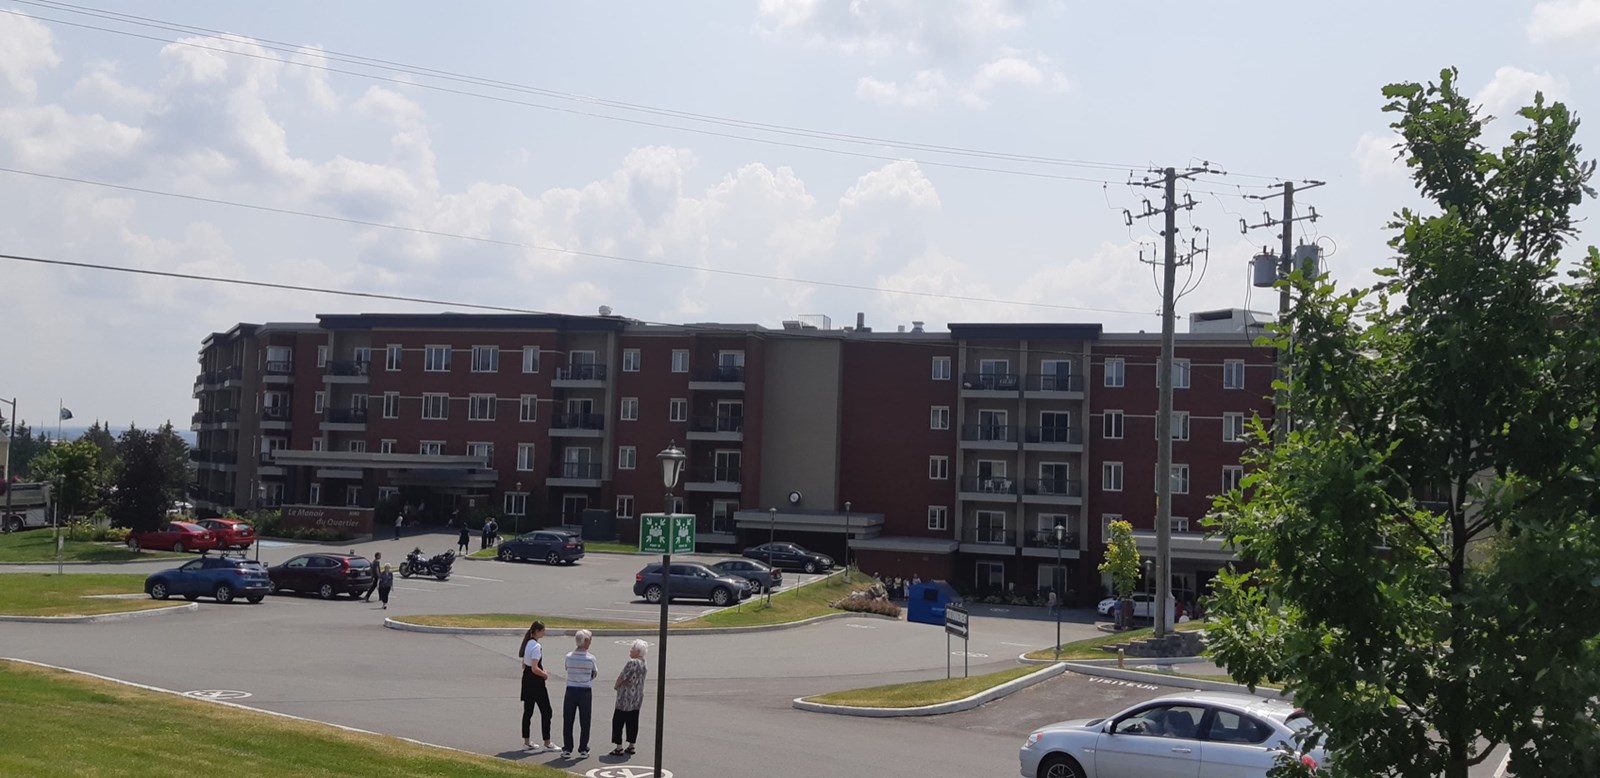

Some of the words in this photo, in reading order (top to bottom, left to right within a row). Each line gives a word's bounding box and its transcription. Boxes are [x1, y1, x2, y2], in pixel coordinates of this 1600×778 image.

[288, 508, 296, 516] Le
[297, 509, 324, 517] Manoir
[316, 518, 326, 527] du
[327, 518, 359, 528] Quartier
[1088, 678, 1158, 690] VISITEUR
